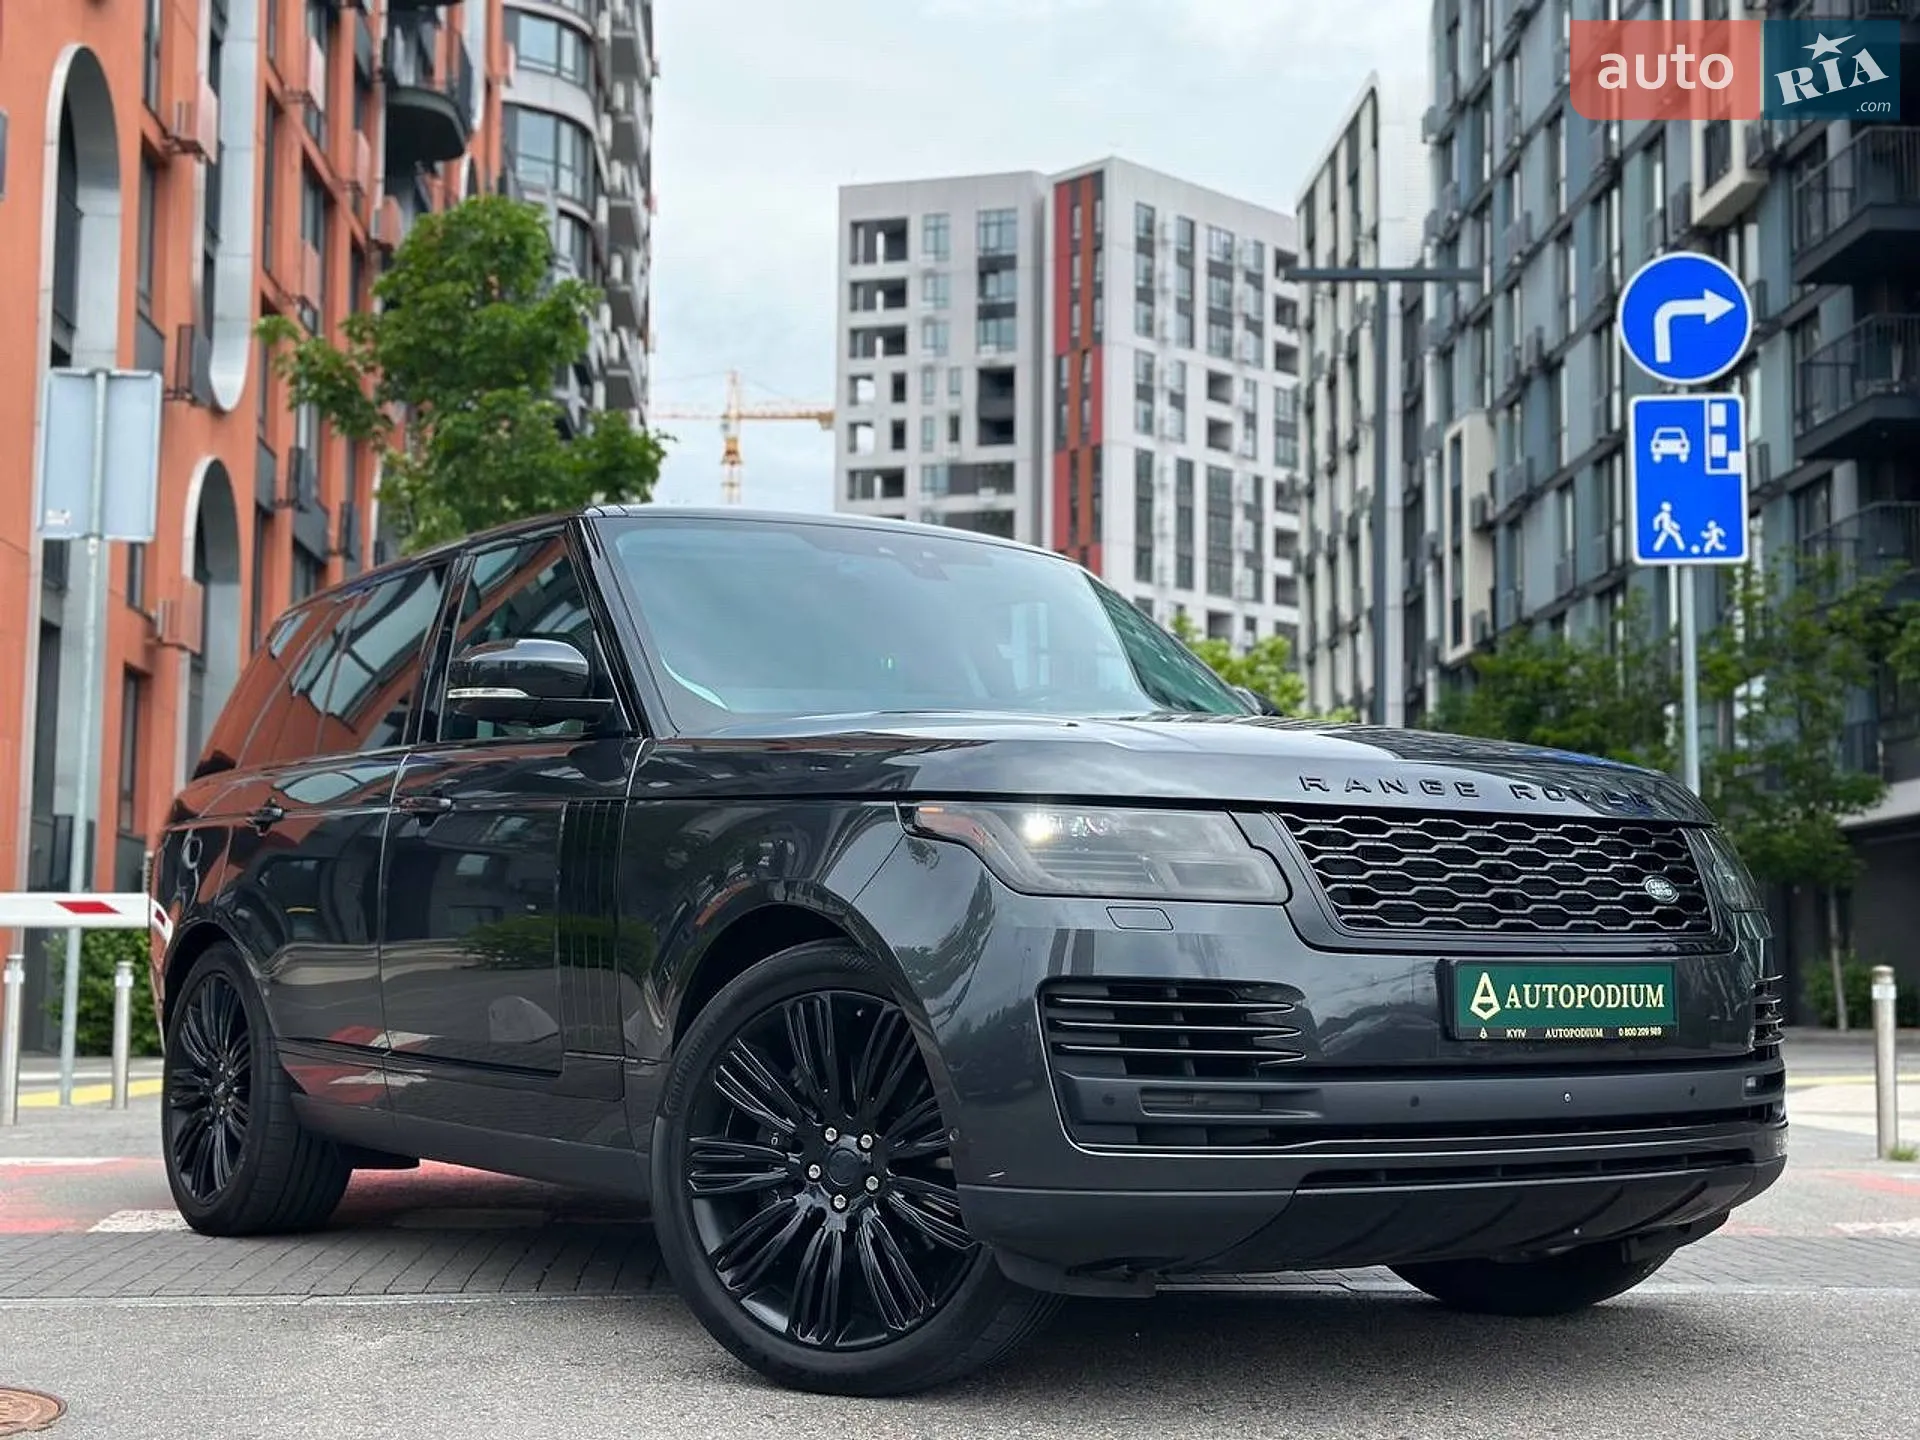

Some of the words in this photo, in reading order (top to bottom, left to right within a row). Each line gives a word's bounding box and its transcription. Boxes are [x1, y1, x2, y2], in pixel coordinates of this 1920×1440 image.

[1299, 775, 1480, 798] RANGE
[1505, 983, 1665, 1009] AUTOPODIUM
[1506, 1028, 1527, 1038] KYIV
[1545, 1027, 1603, 1038] AUTOPODIUM
